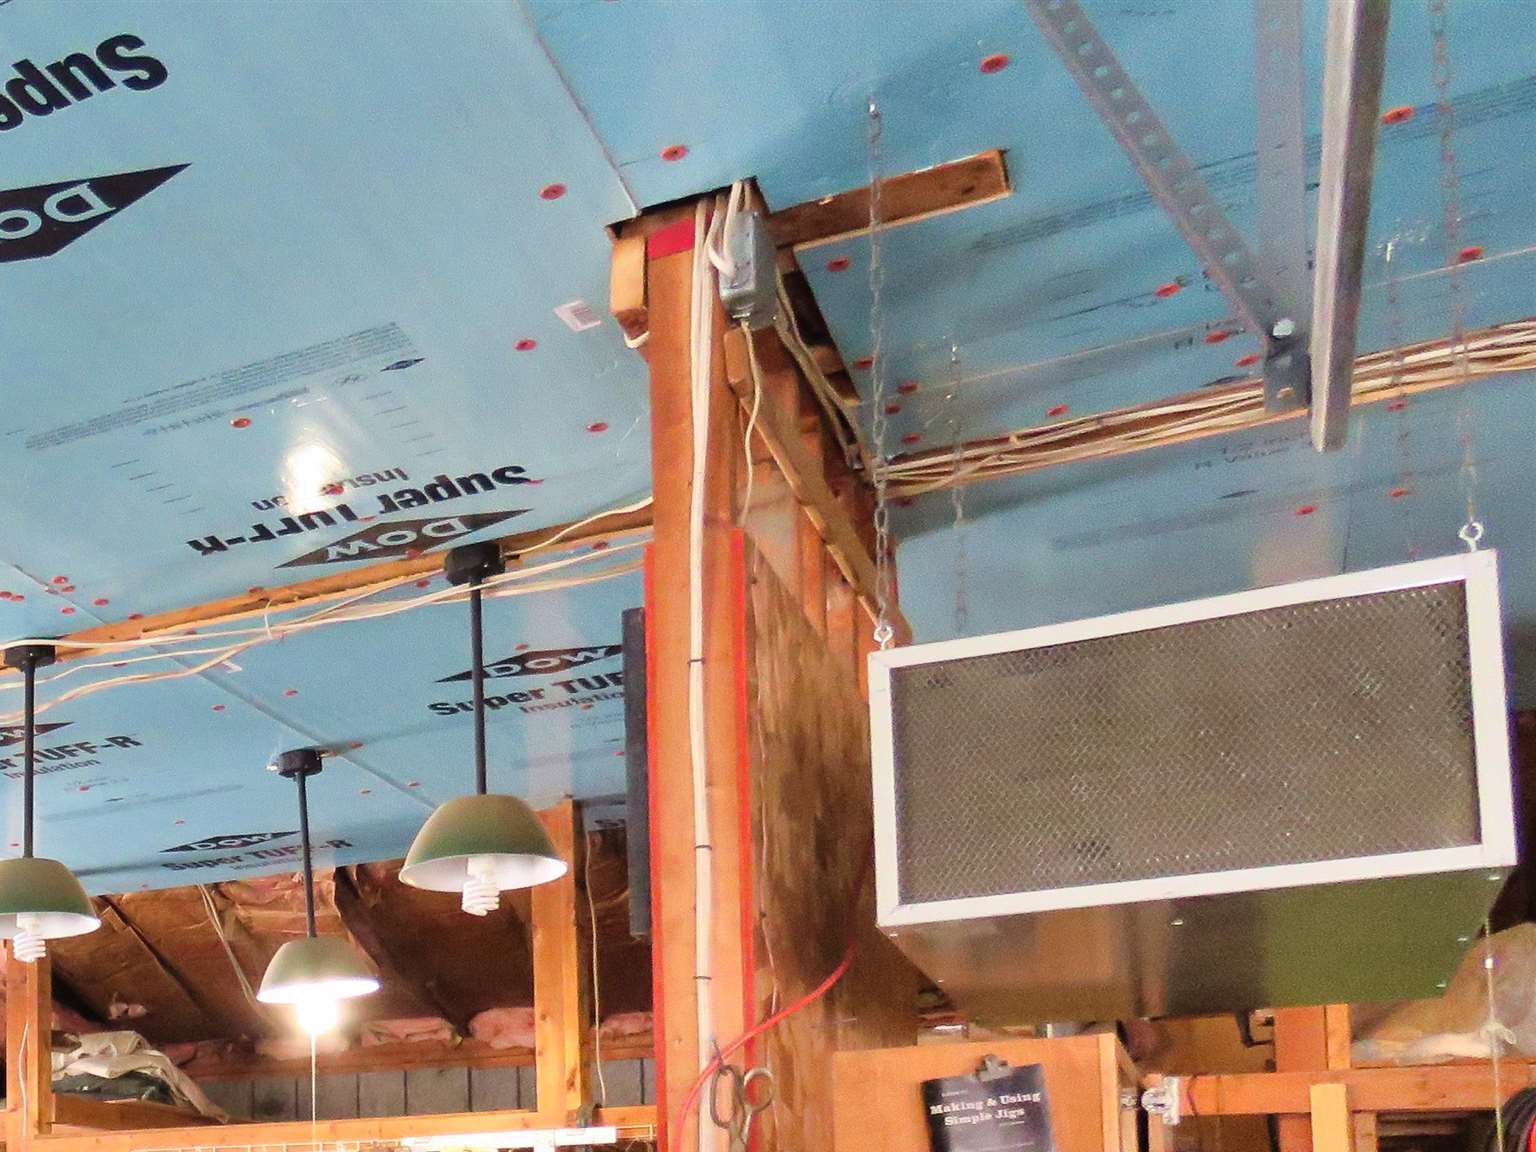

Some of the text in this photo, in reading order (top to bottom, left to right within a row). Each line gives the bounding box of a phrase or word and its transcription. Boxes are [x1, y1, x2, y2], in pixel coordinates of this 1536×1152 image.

[375, 465, 531, 515] Super
[327, 518, 472, 561] DOW
[484, 648, 609, 678] DOW
[189, 832, 275, 850] DOW
[162, 854, 243, 872] Super
[930, 1092, 1041, 1115] Making & Using
[945, 1108, 1025, 1126] Simple Jigs
